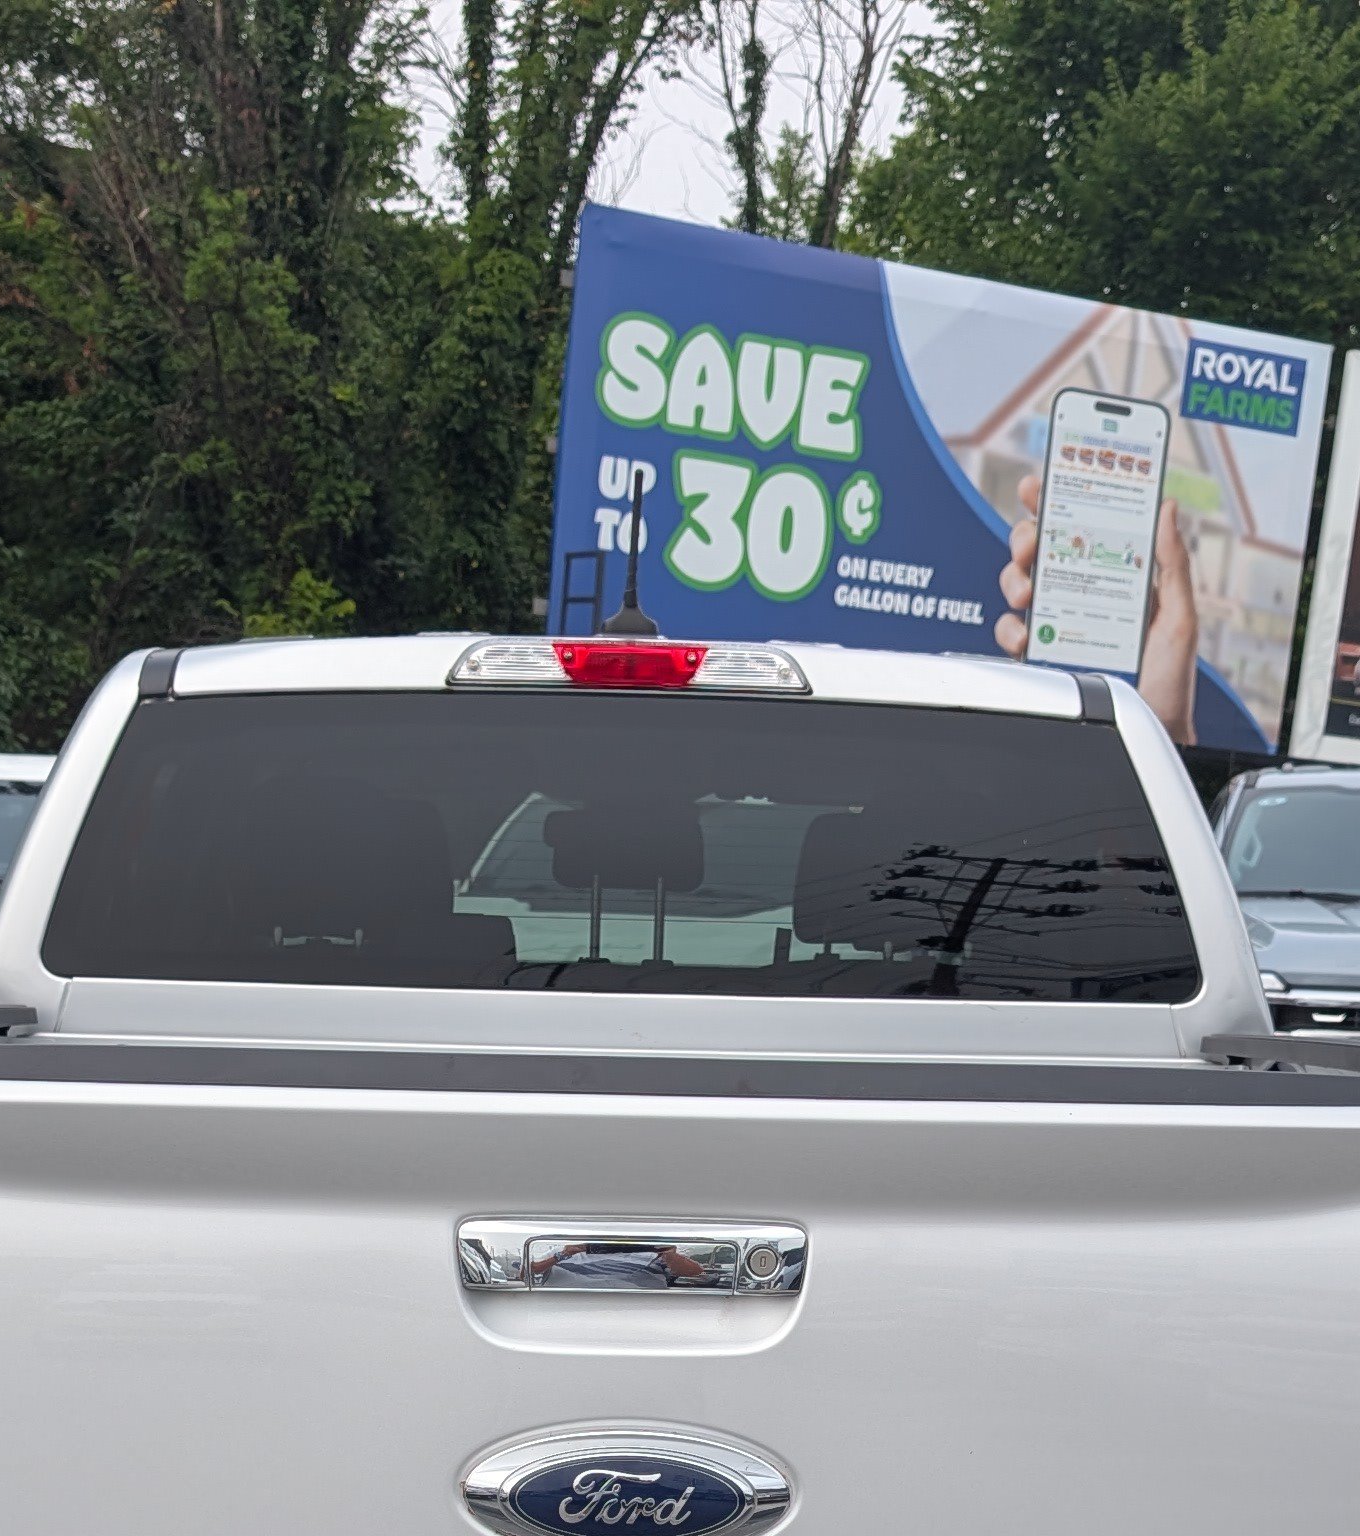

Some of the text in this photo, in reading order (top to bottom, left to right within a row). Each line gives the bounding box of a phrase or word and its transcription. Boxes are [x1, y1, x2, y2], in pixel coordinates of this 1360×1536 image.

[600, 315, 869, 458] SAVE
[1192, 346, 1299, 396] ROYAL
[1187, 382, 1294, 432] FARMS
[598, 455, 656, 502] UP
[594, 508, 648, 554] TO
[837, 555, 934, 589] ON EVERY
[834, 584, 985, 626] GALLON OF FUEL
[558, 1468, 696, 1527] Ford
